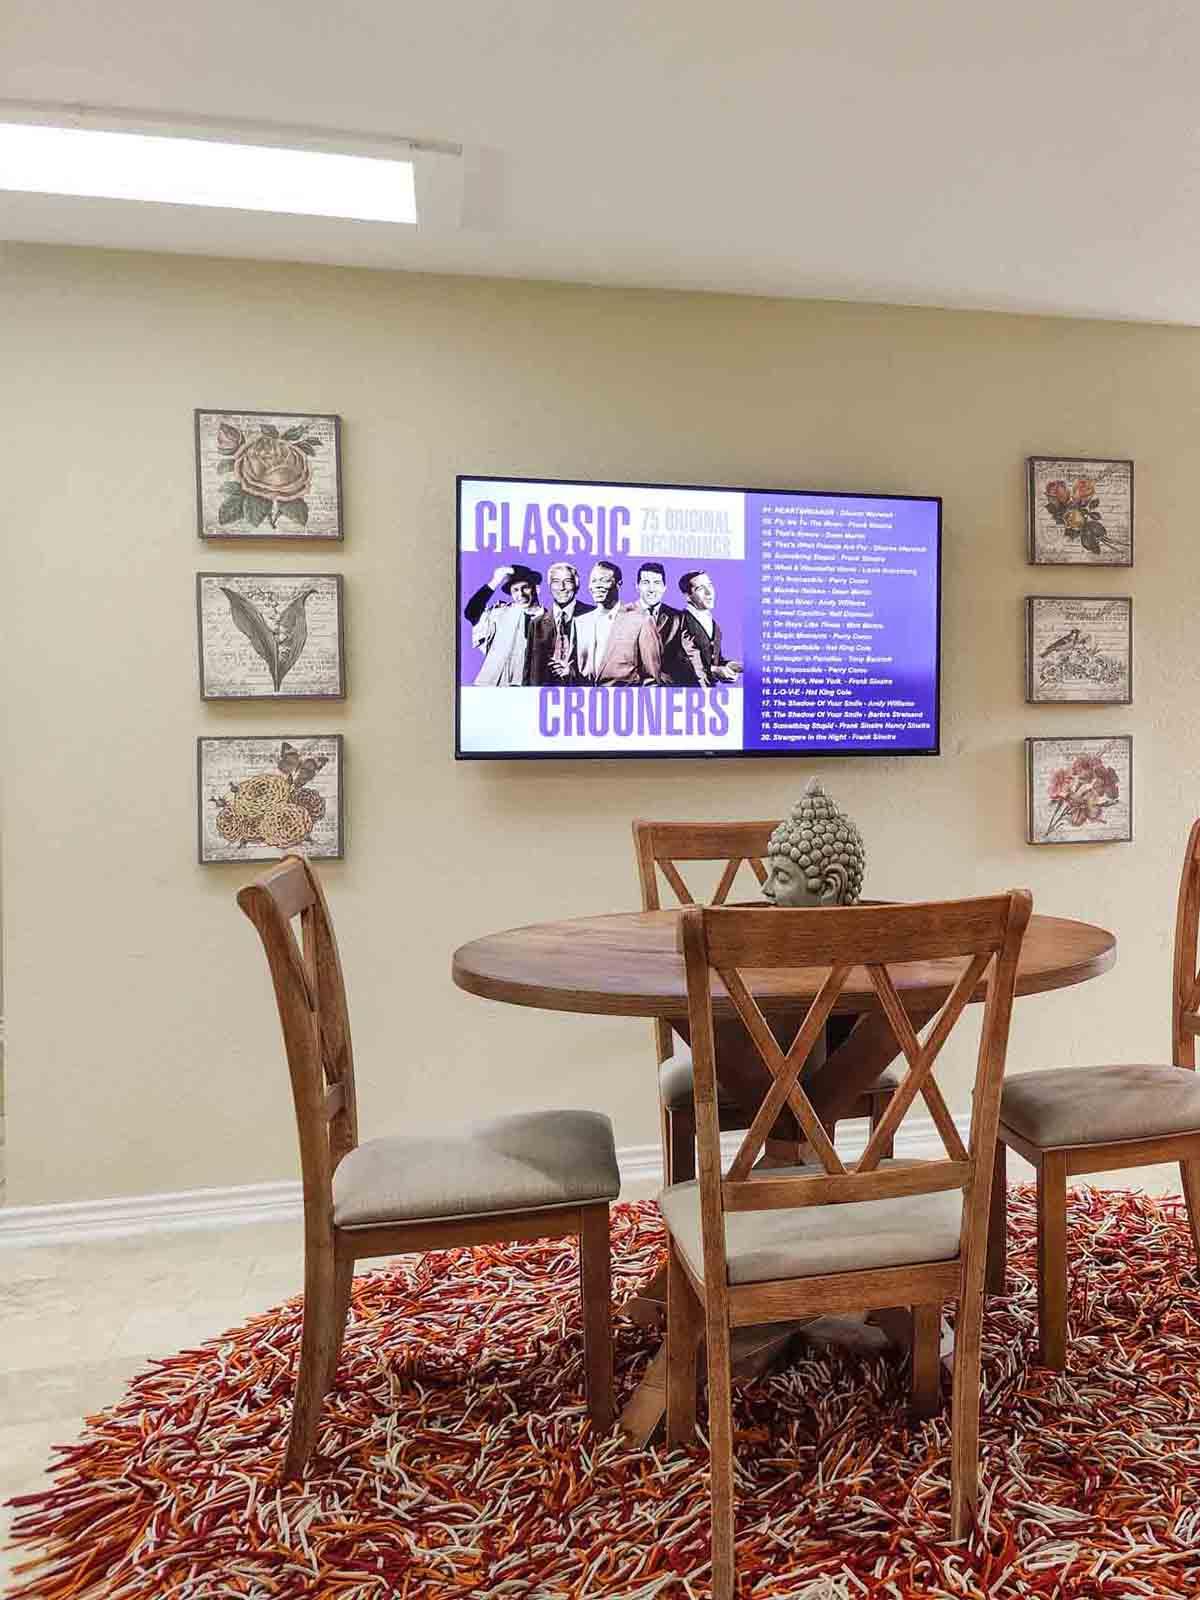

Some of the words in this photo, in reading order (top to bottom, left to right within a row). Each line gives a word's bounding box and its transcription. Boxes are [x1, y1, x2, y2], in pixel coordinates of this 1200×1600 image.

[474, 500, 630, 556] CLASSIC
[664, 508, 732, 533] ORIGINAL
[538, 686, 730, 737] CROONERS
